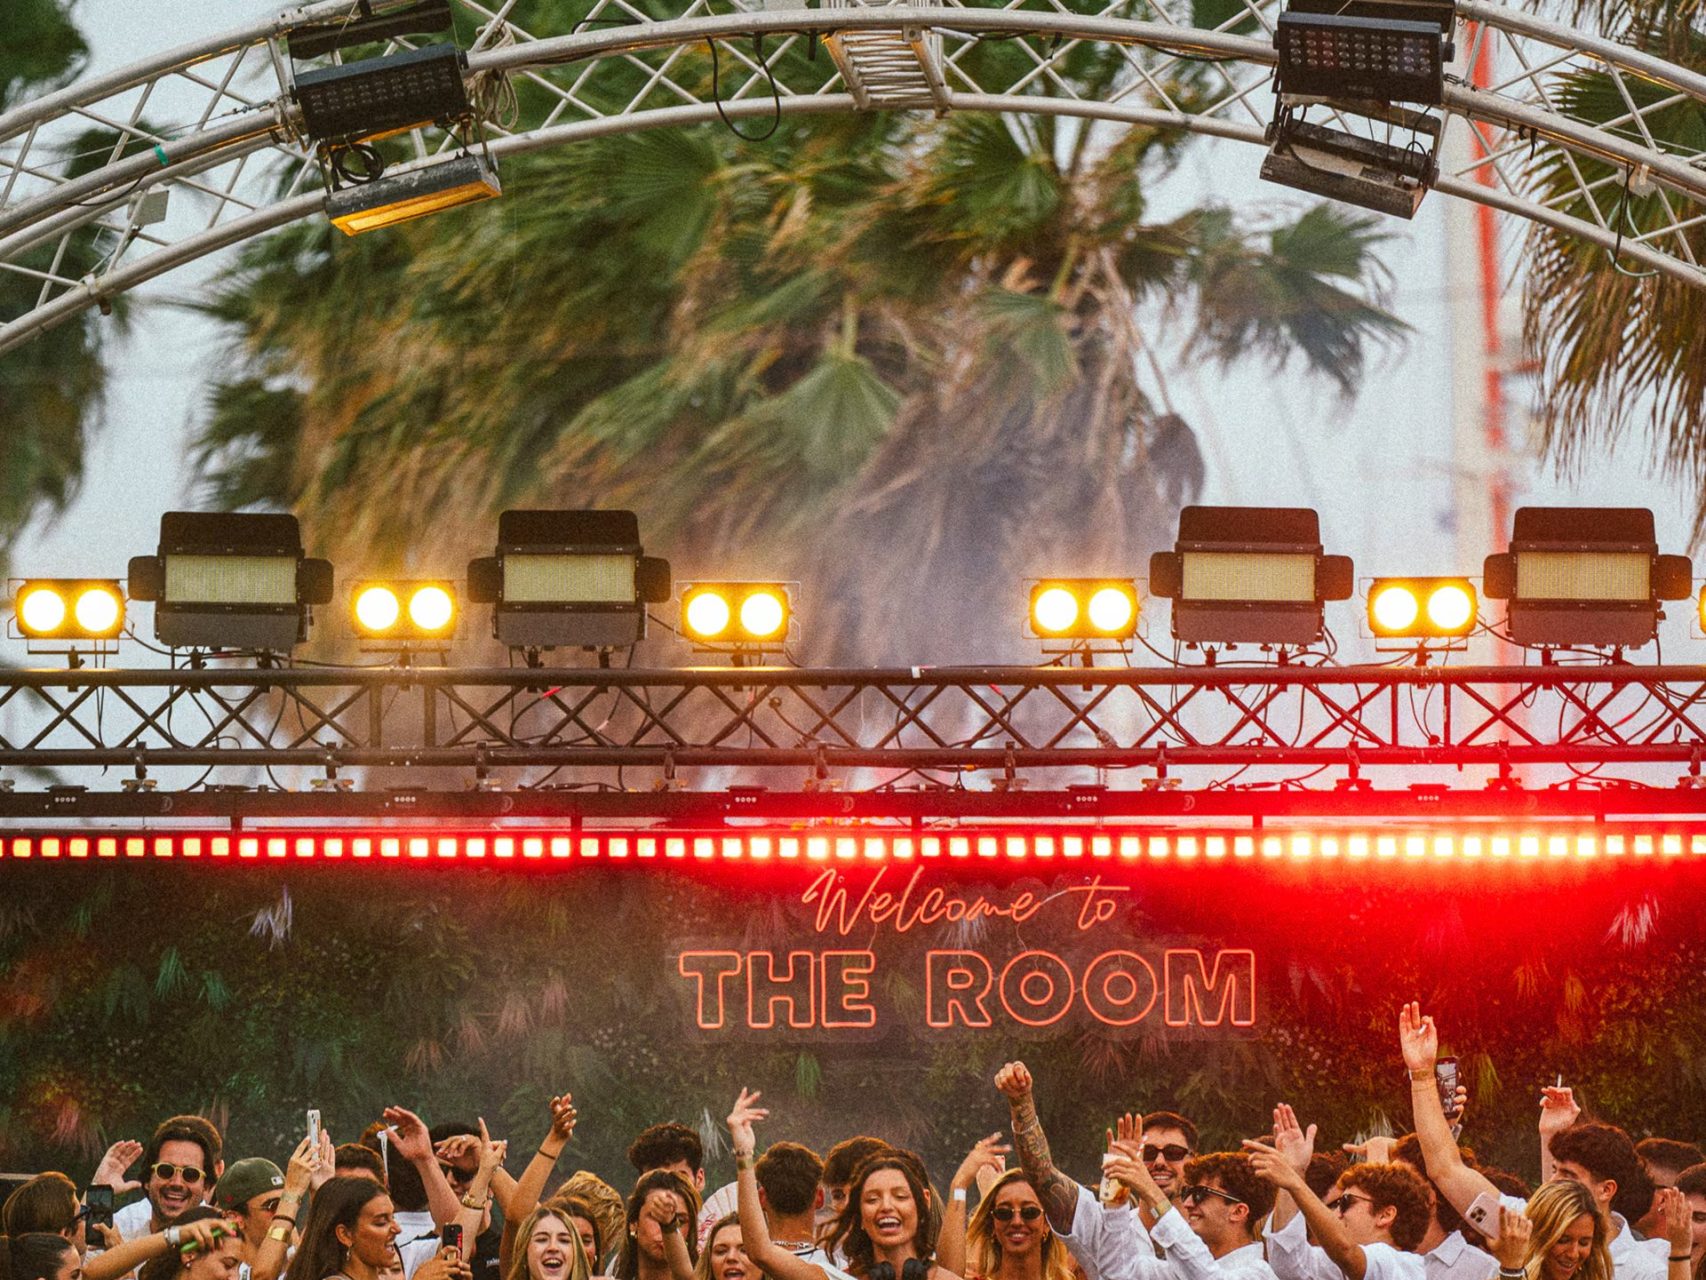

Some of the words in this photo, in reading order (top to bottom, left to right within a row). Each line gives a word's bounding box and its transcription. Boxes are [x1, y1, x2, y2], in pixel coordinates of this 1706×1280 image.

[802, 865, 1041, 936] Welcome
[1067, 875, 1130, 931] to
[679, 950, 877, 1029] THE
[926, 949, 1256, 1028] ROOM
